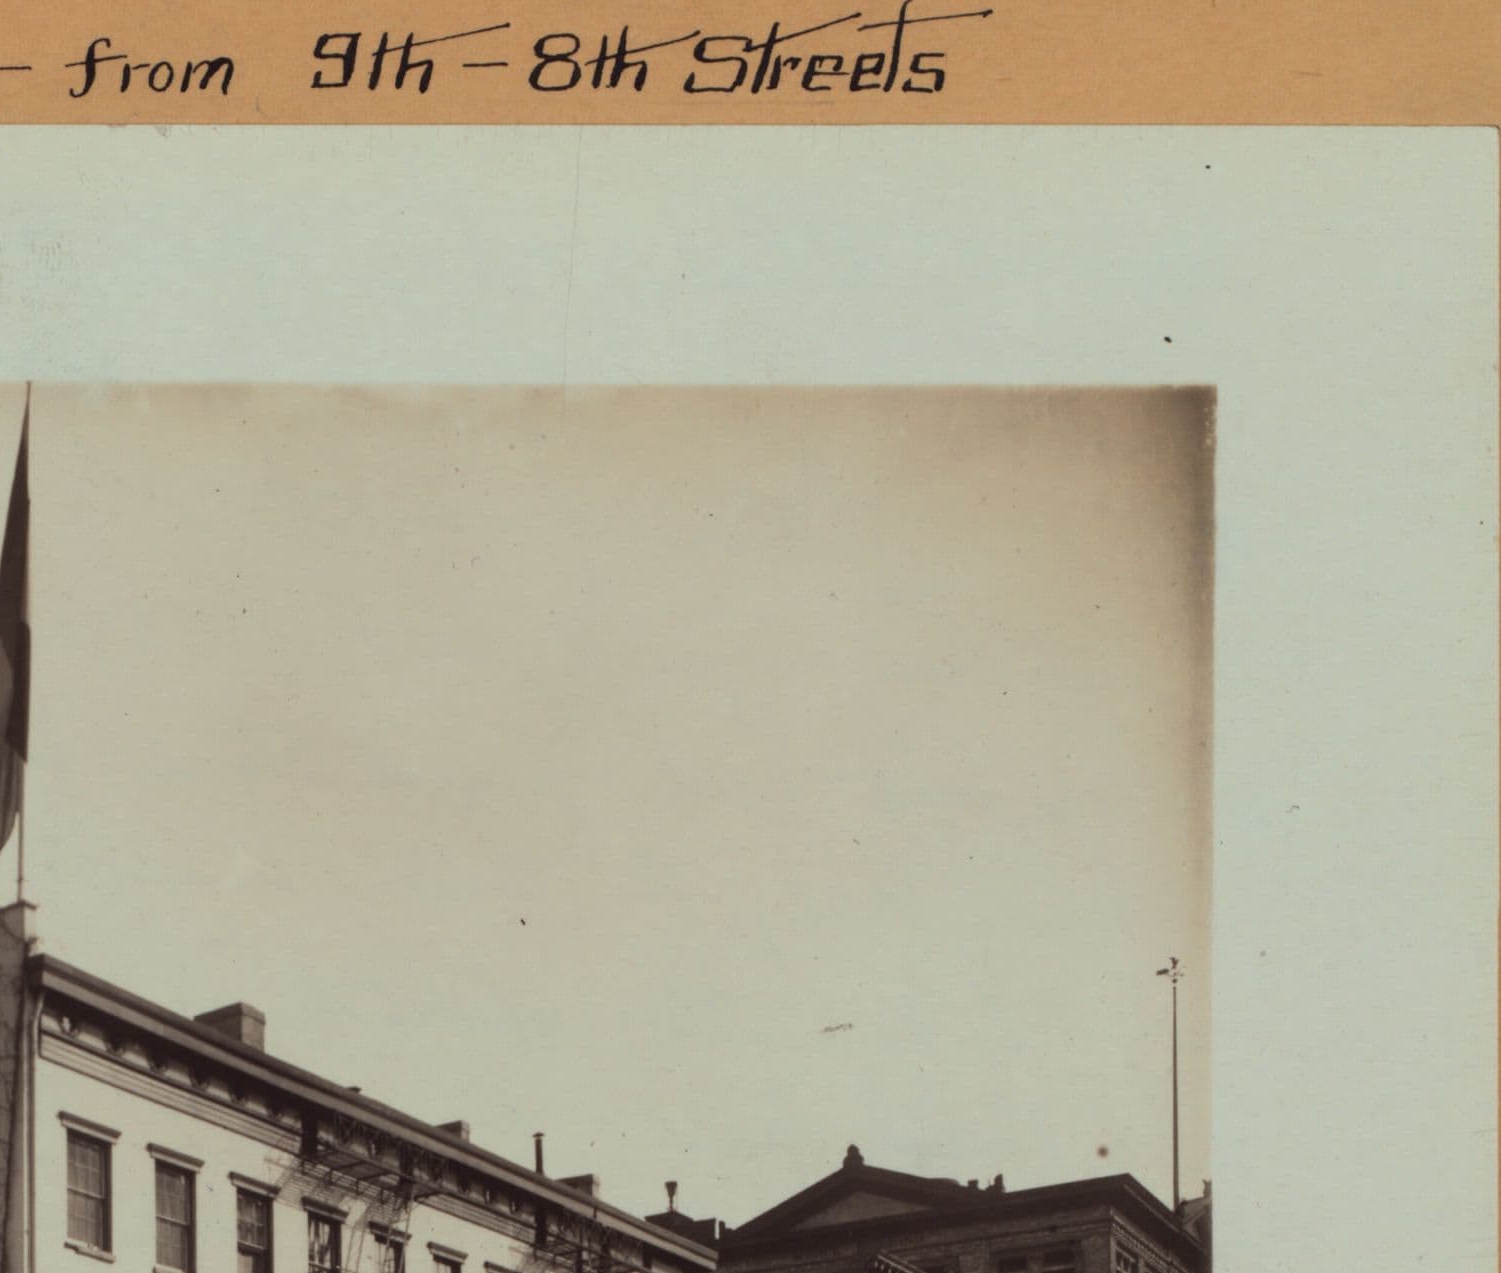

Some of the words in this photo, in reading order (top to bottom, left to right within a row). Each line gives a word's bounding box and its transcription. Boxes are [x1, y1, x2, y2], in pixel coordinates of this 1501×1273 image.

[66, 37, 234, 98] from
[312, 23, 510, 94] 9th
[530, 32, 695, 94] 8th
[683, 0, 992, 94] Streets
